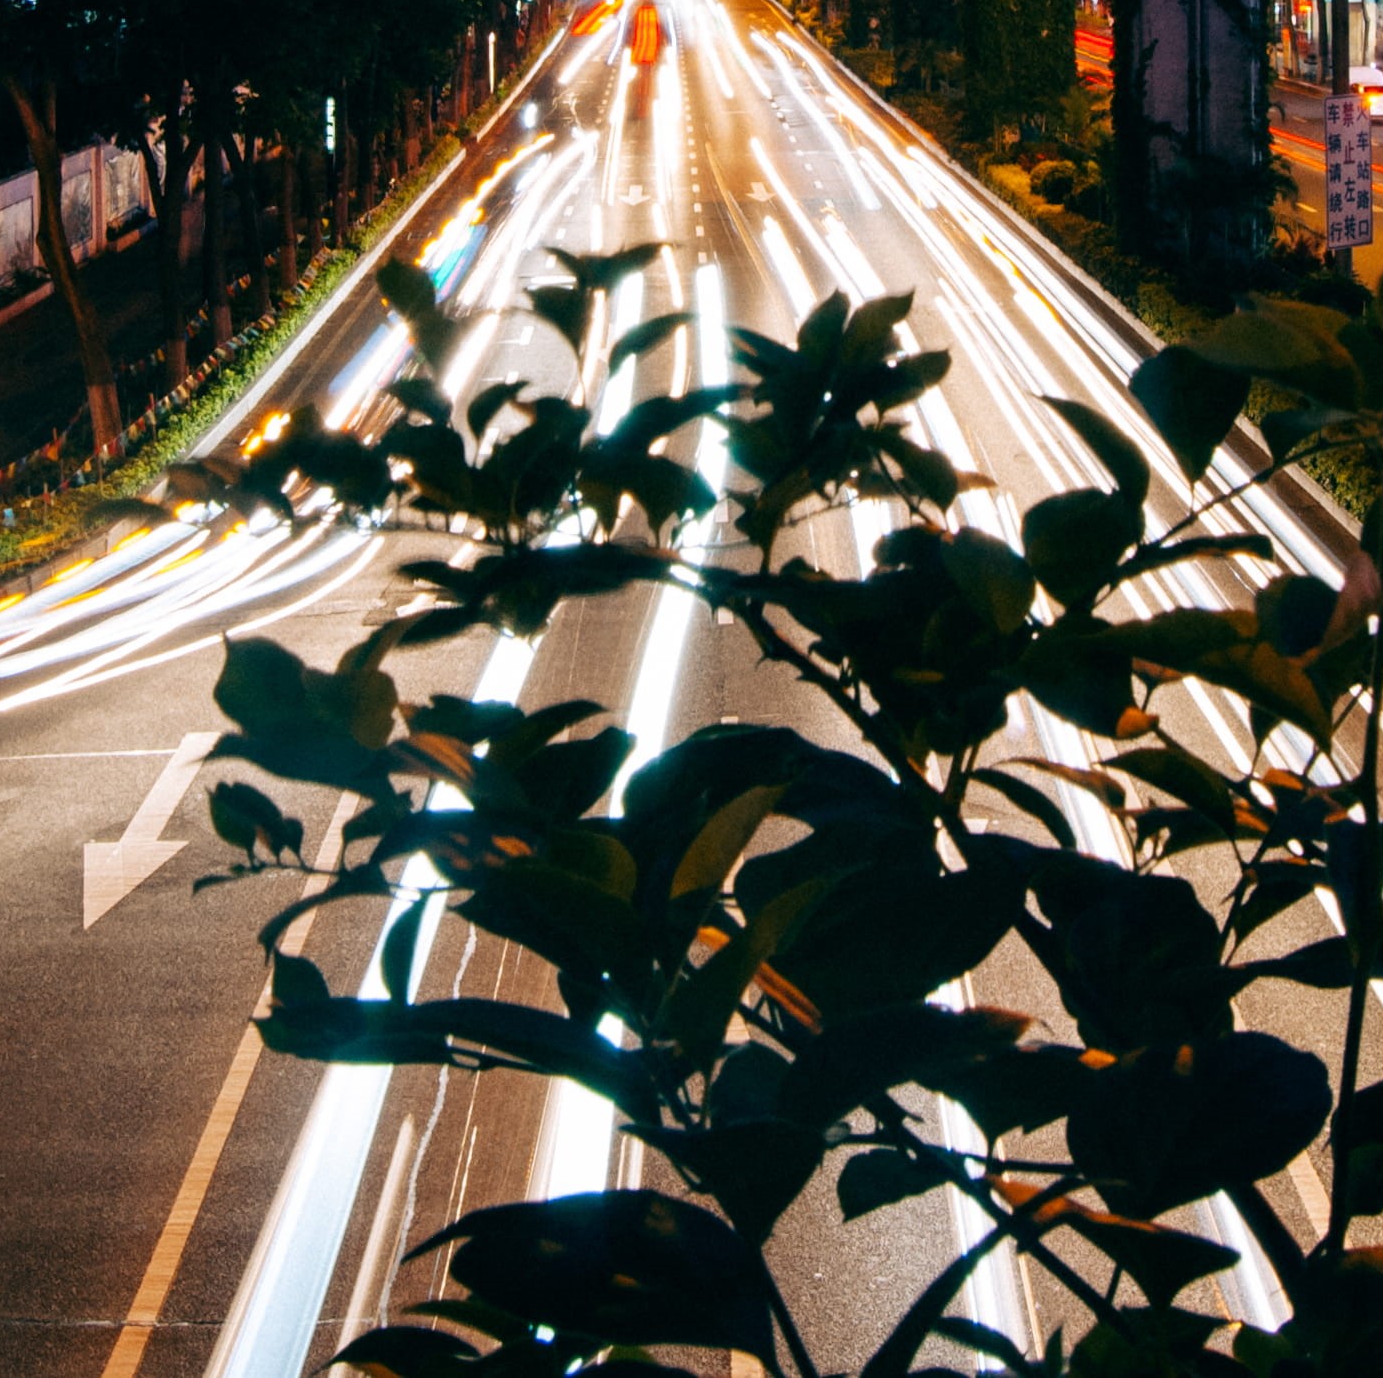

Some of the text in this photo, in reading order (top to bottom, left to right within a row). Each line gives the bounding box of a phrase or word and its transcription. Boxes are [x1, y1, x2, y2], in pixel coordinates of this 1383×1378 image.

[1328, 103, 1343, 243] 车辆请绕行
[1343, 102, 1356, 240] 禁止左转
[1356, 104, 1369, 238] 火车站路口
